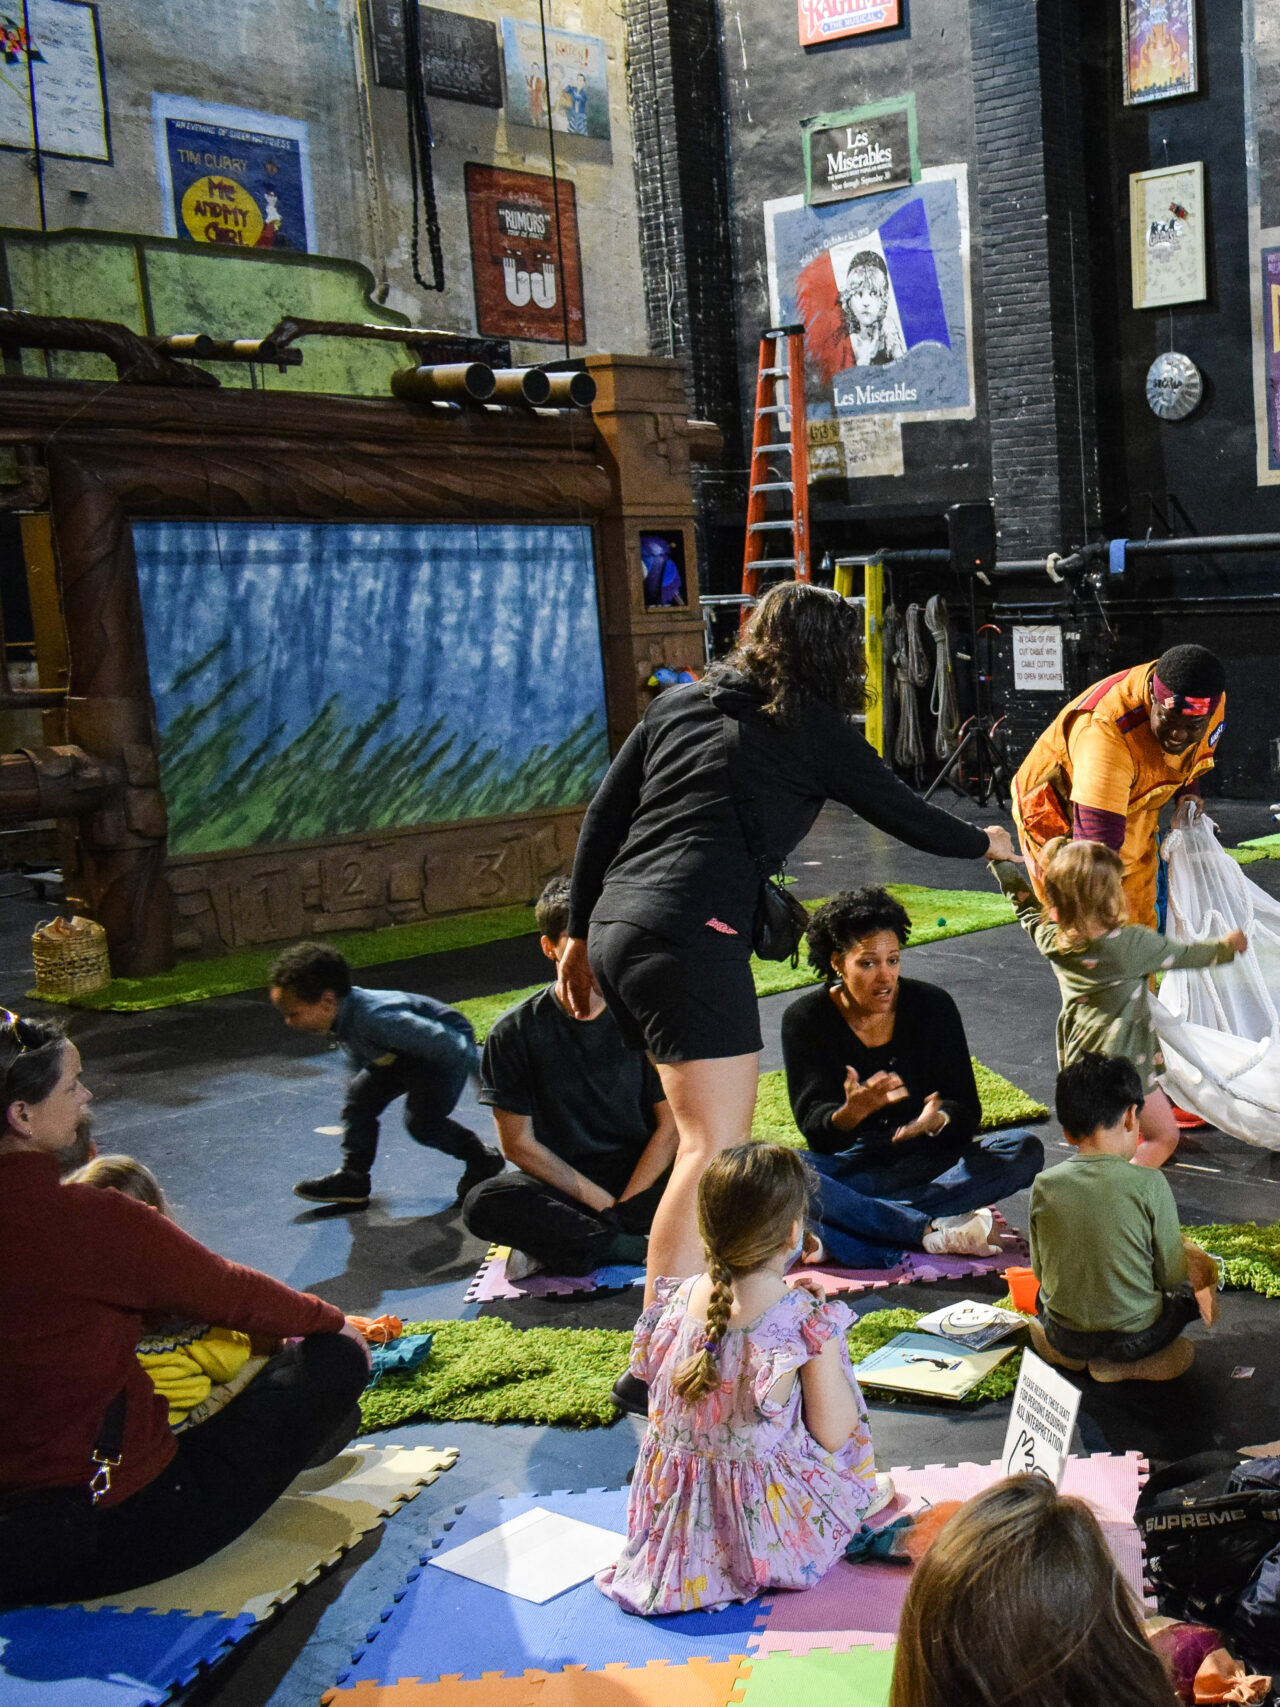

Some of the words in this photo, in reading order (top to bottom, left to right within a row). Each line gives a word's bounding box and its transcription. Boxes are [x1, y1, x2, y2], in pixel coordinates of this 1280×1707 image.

[846, 128, 868, 149] Les
[178, 149, 201, 164] TIM
[204, 153, 248, 172] CURRY
[827, 143, 892, 174] Misérables
[833, 387, 854, 407] Les
[854, 383, 917, 405] Misérables
[342, 862, 365, 895] 2
[470, 851, 507, 897] 3
[1020, 1387, 1028, 1402] FOR
[1027, 1394, 1045, 1419] PERSONS
[1045, 1409, 1067, 1437] REQUIRING
[1023, 1374, 1035, 1392] PLEASE
[1034, 1384, 1049, 1404] RESERVE
[1048, 1396, 1060, 1413] THESE
[1059, 1405, 1070, 1422] SEATS
[1016, 1403, 1025, 1421] ASL
[1025, 1410, 1064, 1454] INTERPRETATION
[1146, 1508, 1247, 1532] SUPREME
